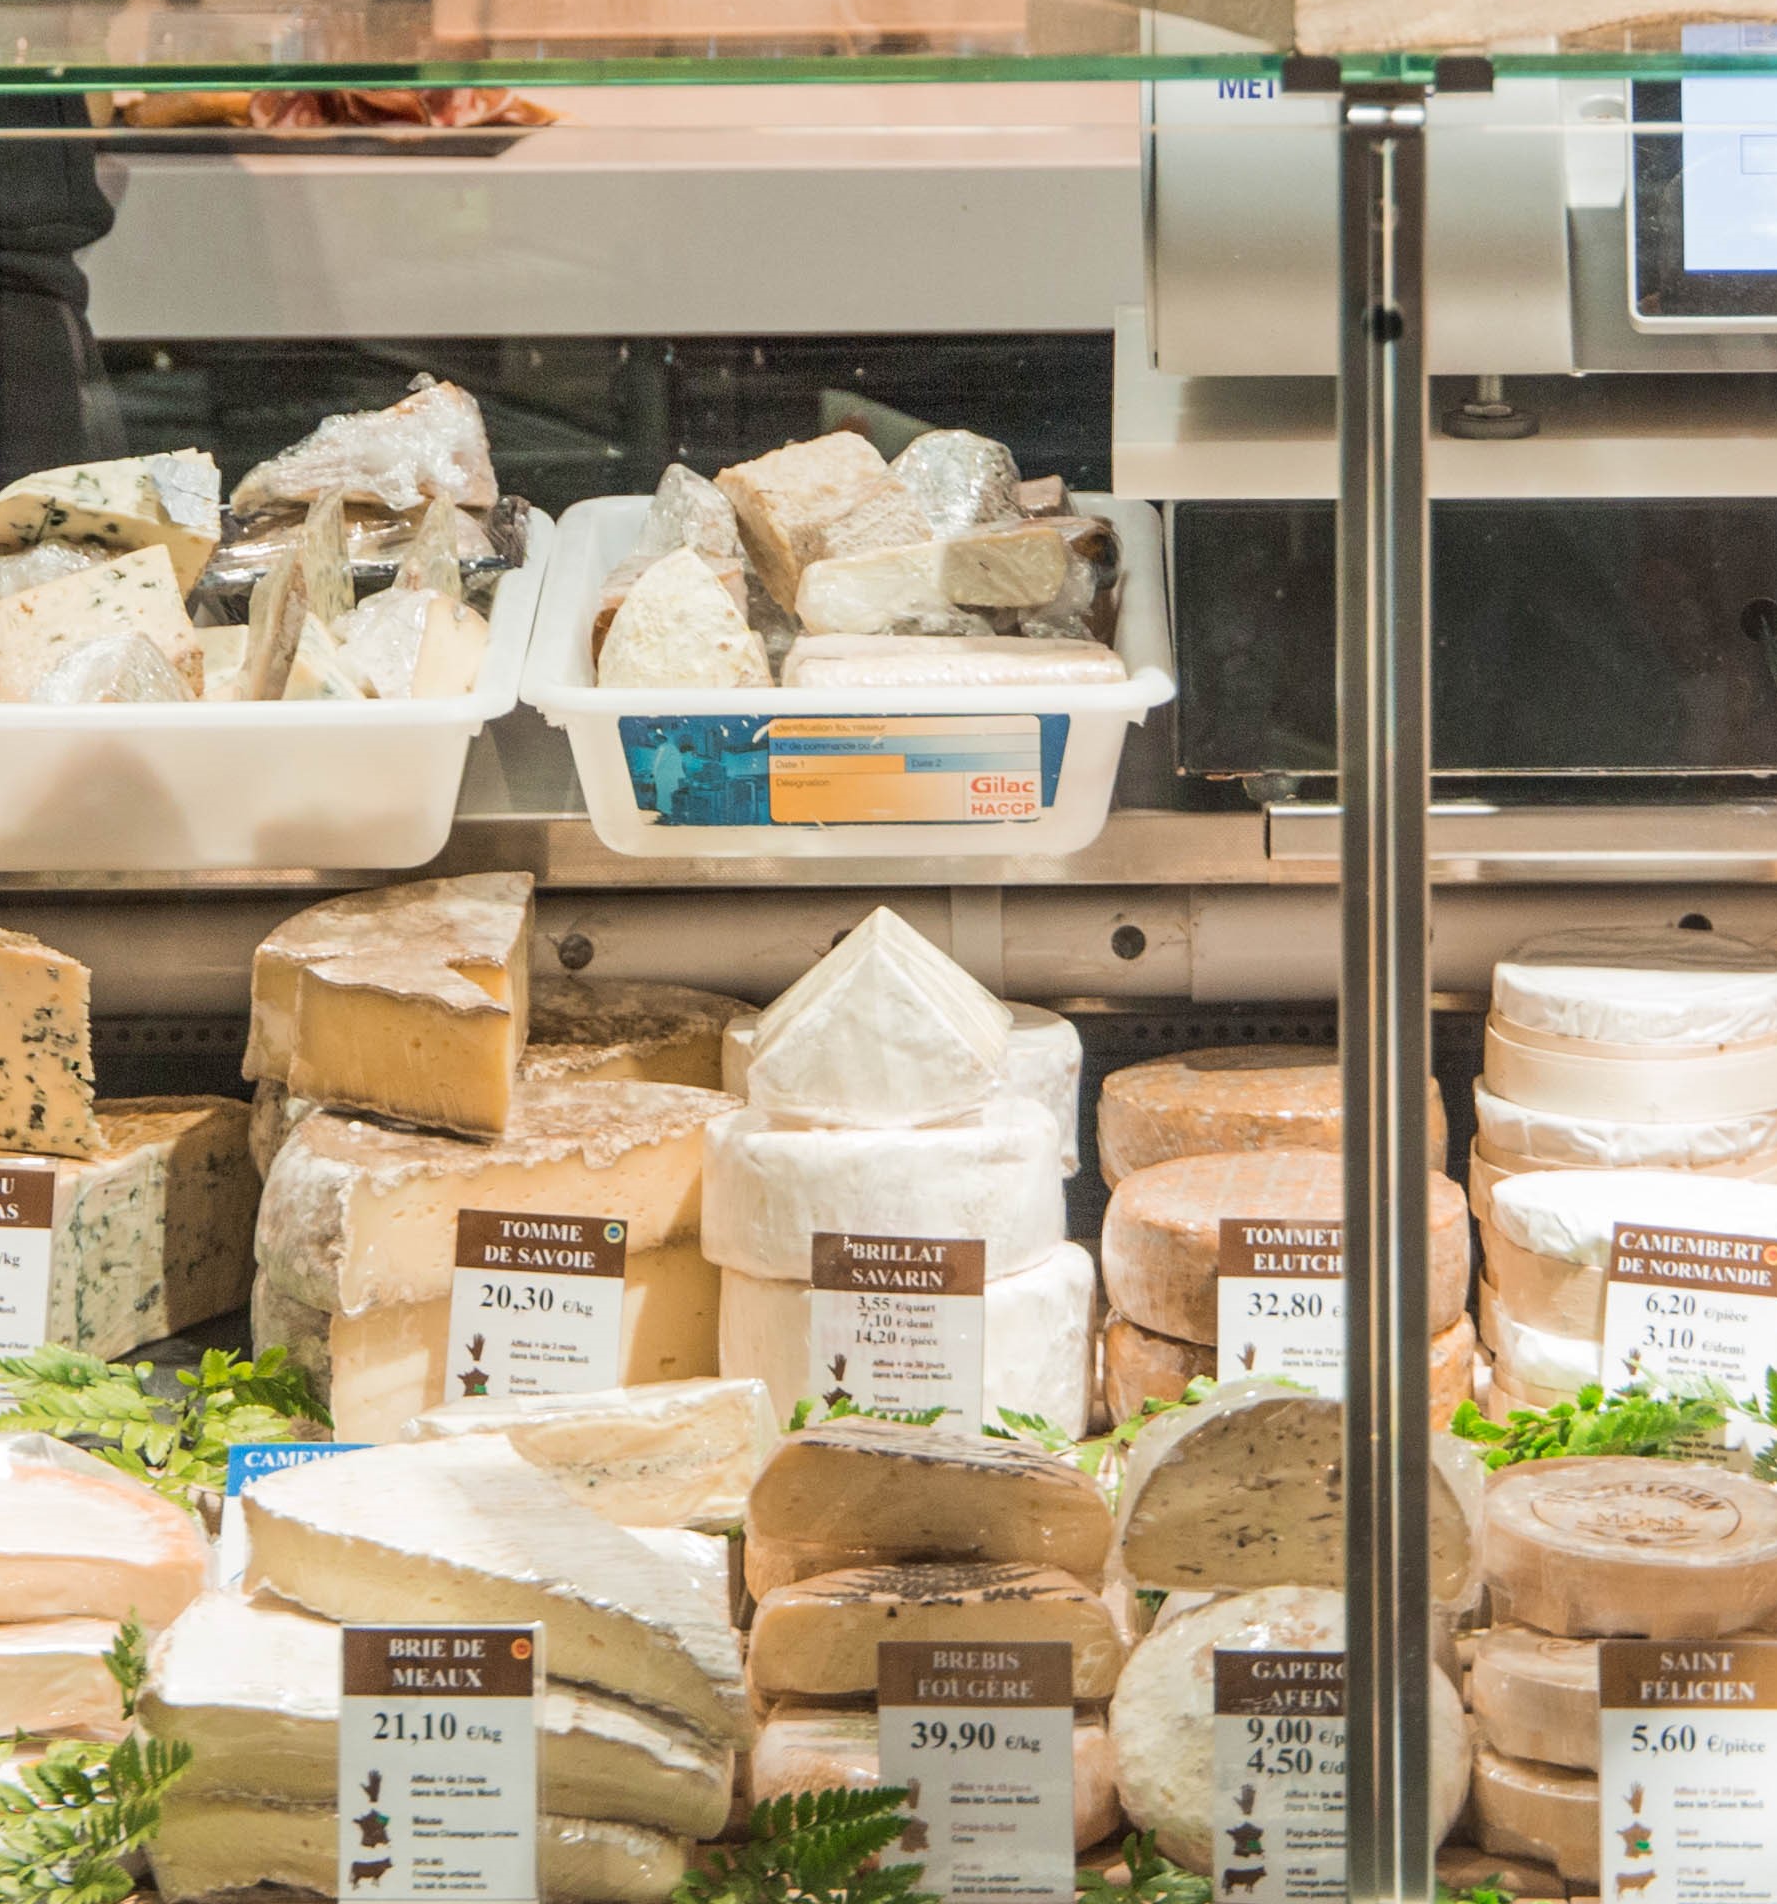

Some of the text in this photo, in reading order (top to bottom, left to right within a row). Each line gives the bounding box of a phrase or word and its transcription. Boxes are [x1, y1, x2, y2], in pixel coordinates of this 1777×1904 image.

[775, 759, 797, 769] Date
[912, 758, 933, 767] Date
[970, 776, 1034, 794] Gilac
[971, 802, 1036, 815] HACCP
[500, 1220, 583, 1242] TOMME
[1242, 1227, 1343, 1246] TOMMET
[852, 1243, 947, 1263] BRILLAT
[1618, 1231, 1763, 1262] CAMEMBERT
[484, 1246, 595, 1269] DE SAVOIE
[1253, 1253, 1343, 1272] ELUTCH
[852, 1268, 944, 1287] SAVARIN
[1618, 1256, 1772, 1287] DE NORMANDIE
[479, 1283, 594, 1317] 20,30 €/kg
[857, 1296, 890, 1311] 3,55
[1248, 1293, 1322, 1321] 32,80
[1646, 1292, 1696, 1317] 6,20
[859, 1313, 892, 1328] 7,10
[855, 1330, 896, 1344] 14,20
[1643, 1324, 1693, 1350] 3,10
[389, 1638, 486, 1659] BRIE DE
[932, 1650, 1020, 1670] BREBIS
[1252, 1661, 1346, 1680] GAPERO
[1660, 1651, 1734, 1672] SAINT
[392, 1668, 483, 1688] MEAUX
[917, 1676, 1034, 1698] FOUGÈRE
[1640, 1676, 1756, 1701] FÉLICIEN
[1272, 1689, 1341, 1708] AFFIN
[373, 1712, 503, 1745] 21,10 €/kg
[910, 1721, 1041, 1753] 39,90 €/kg
[1247, 1717, 1313, 1747] 9,00
[1631, 1724, 1765, 1757] 5,60 €/pièce
[1247, 1748, 1313, 1781] 4,50
